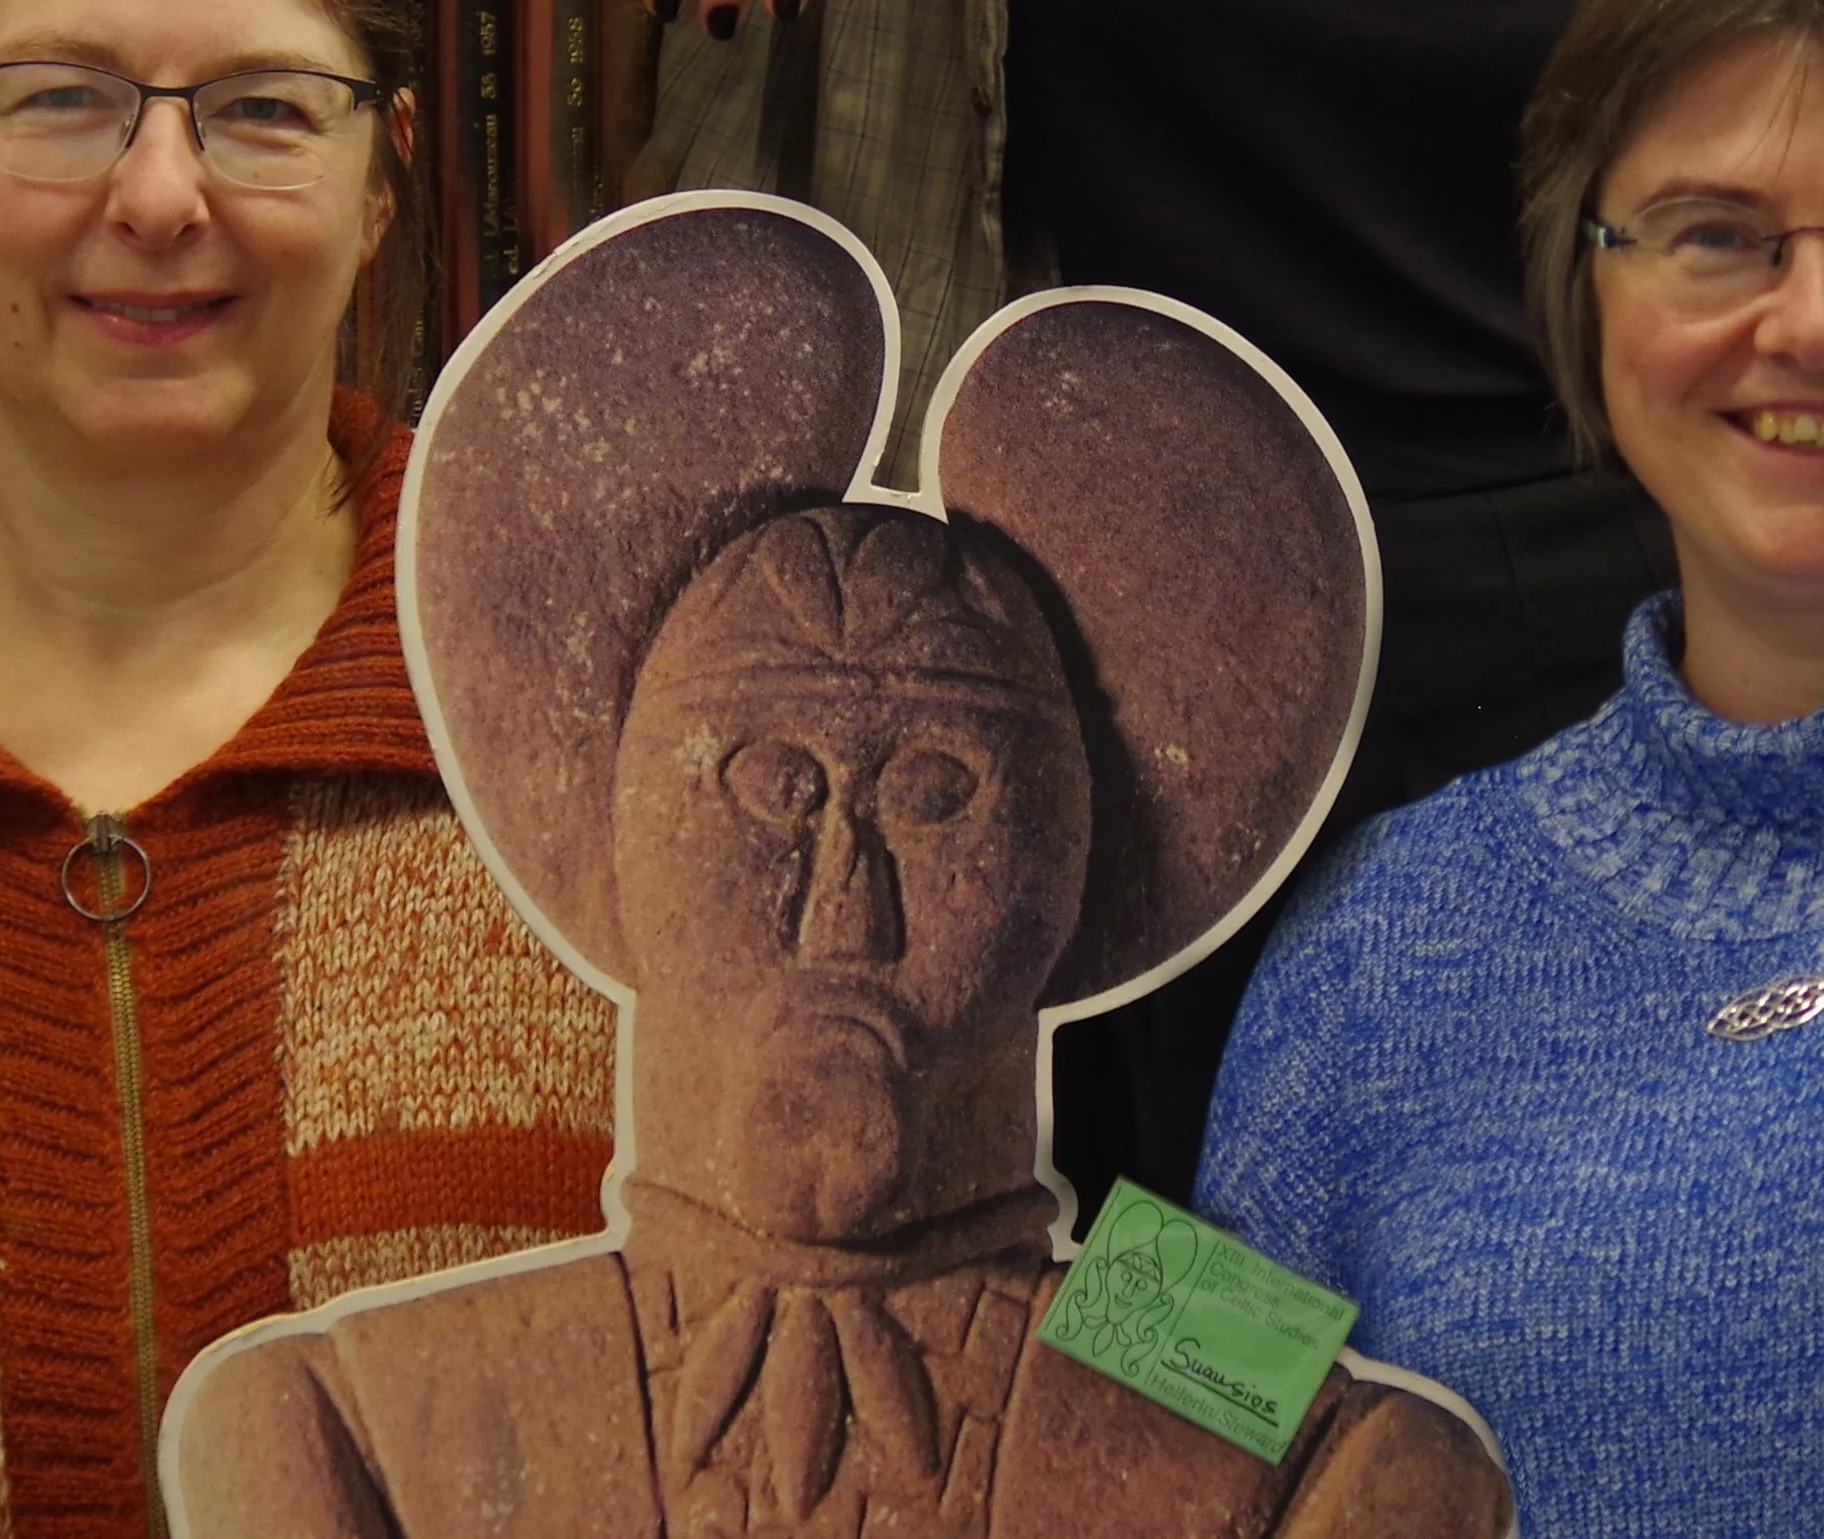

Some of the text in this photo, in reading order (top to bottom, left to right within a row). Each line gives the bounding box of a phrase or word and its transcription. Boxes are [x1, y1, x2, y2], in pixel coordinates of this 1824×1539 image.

[1200, 1277, 1320, 1351] of Celtic Studies
[1209, 1261, 1281, 1310] Congress
[1253, 1262, 1346, 1323] International
